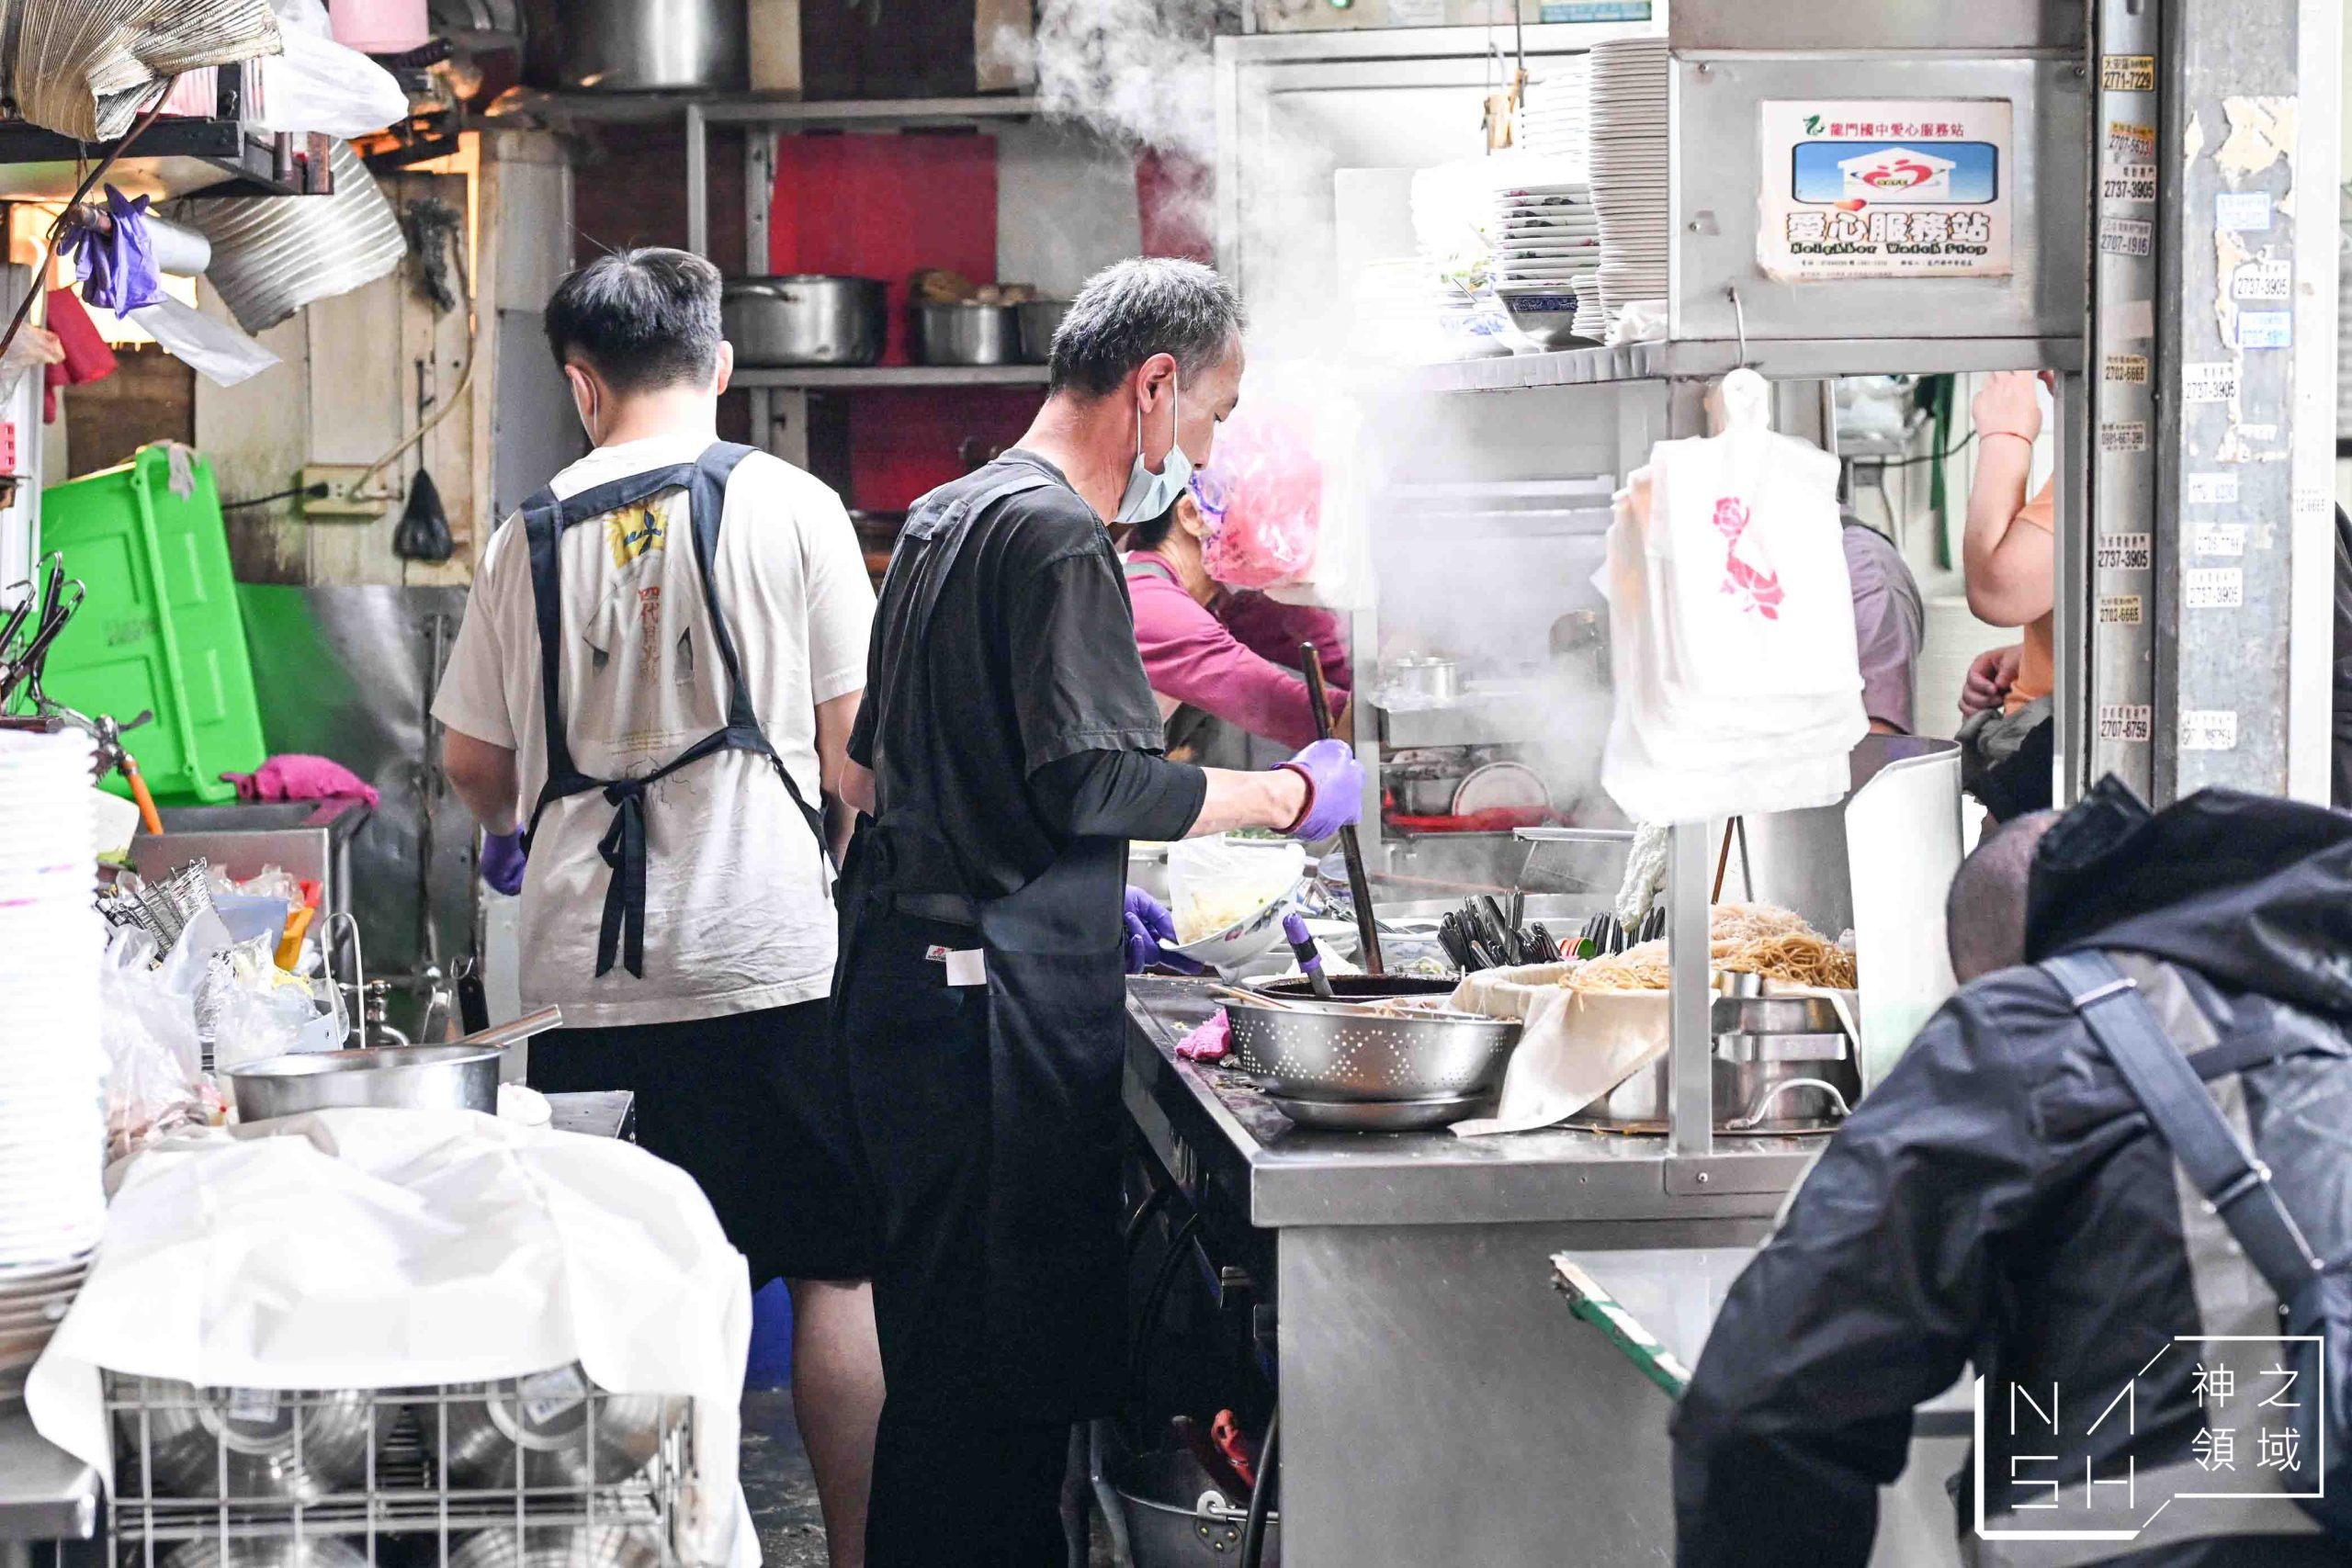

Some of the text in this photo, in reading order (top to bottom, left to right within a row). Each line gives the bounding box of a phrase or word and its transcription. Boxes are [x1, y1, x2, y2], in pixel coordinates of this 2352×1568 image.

[1830, 122, 1964, 138] 龍門國中愛心服務站
[2104, 180, 2154, 199] 2737-3905
[1787, 211, 1991, 243] 愛心服務站
[1791, 243, 1988, 256] Neighbor Watch Stop
[2098, 550, 2148, 568] 2737-3905
